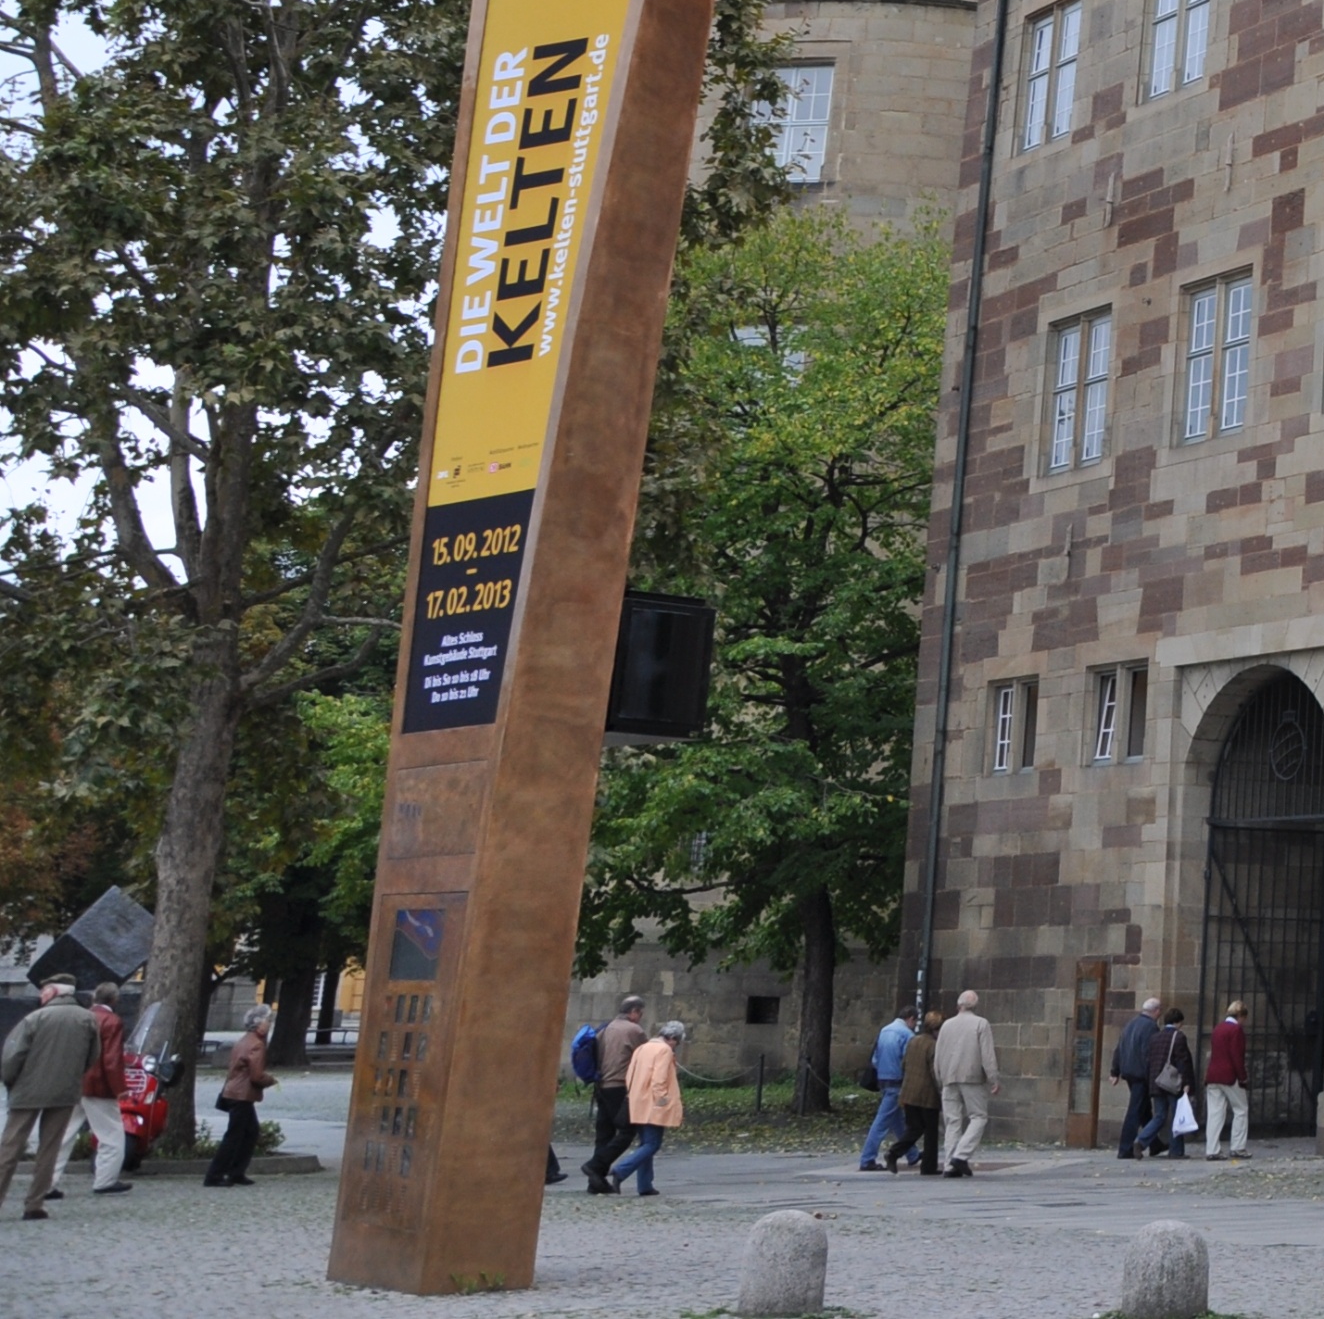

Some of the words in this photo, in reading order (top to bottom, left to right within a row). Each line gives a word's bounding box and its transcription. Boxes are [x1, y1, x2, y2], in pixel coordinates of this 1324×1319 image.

[485, 47, 528, 145] DER
[466, 155, 511, 287] WELT
[486, 37, 589, 368] KELTEN
[538, 33, 610, 357] www.kelten-stuttgart.de
[454, 289, 492, 375] DIE
[441, 635, 458, 647] Altes
[459, 631, 484, 644] Schloss
[468, 644, 497, 660] Stuttgart
[479, 668, 491, 681] Uhr
[467, 685, 479, 698] Uhr
